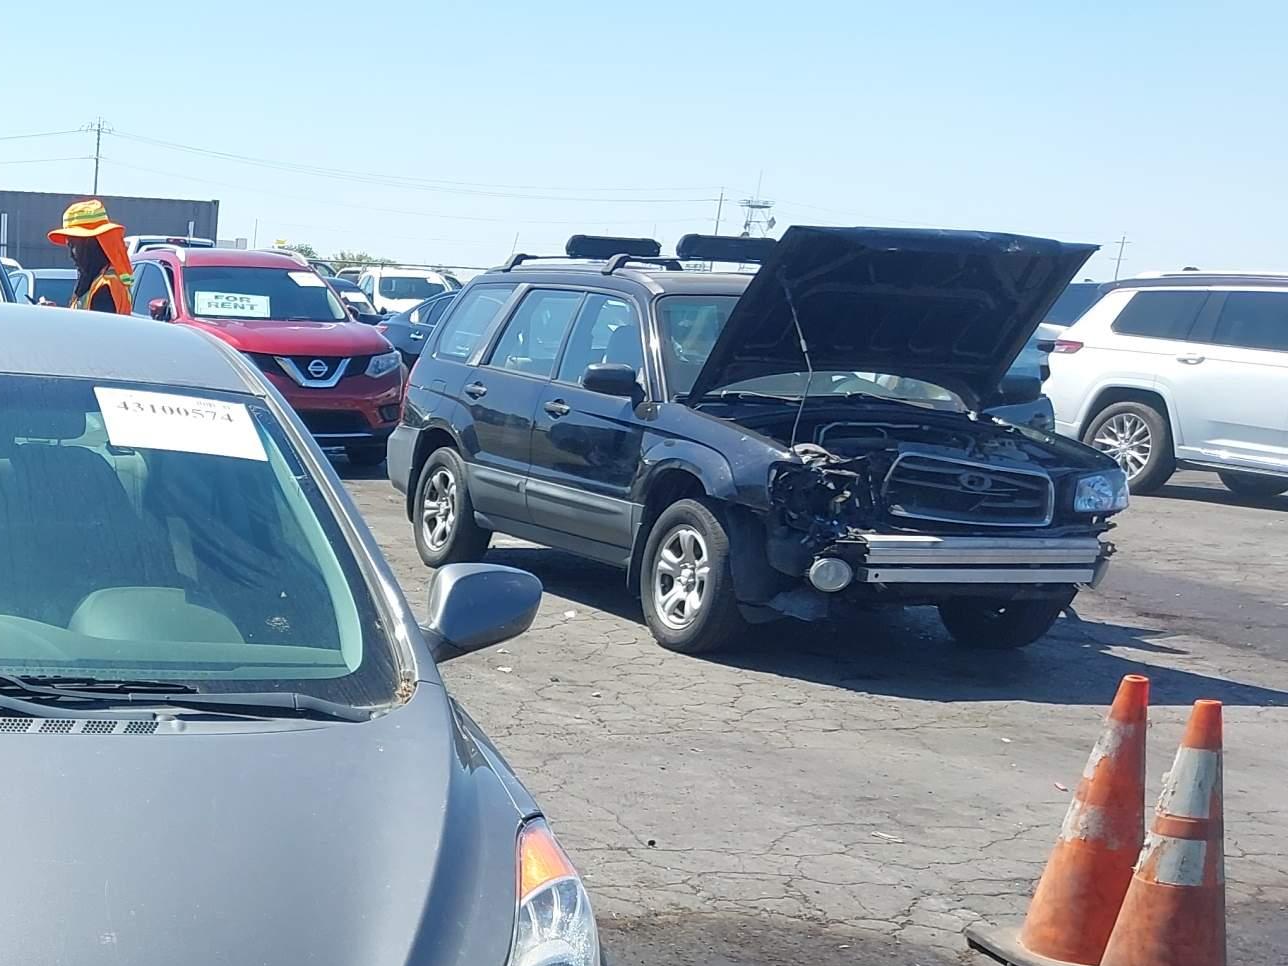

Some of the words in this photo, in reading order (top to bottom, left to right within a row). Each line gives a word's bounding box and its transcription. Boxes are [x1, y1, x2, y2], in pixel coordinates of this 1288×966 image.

[214, 294, 251, 303] FOR
[207, 301, 258, 311] RENT
[117, 401, 234, 422] 43100574
